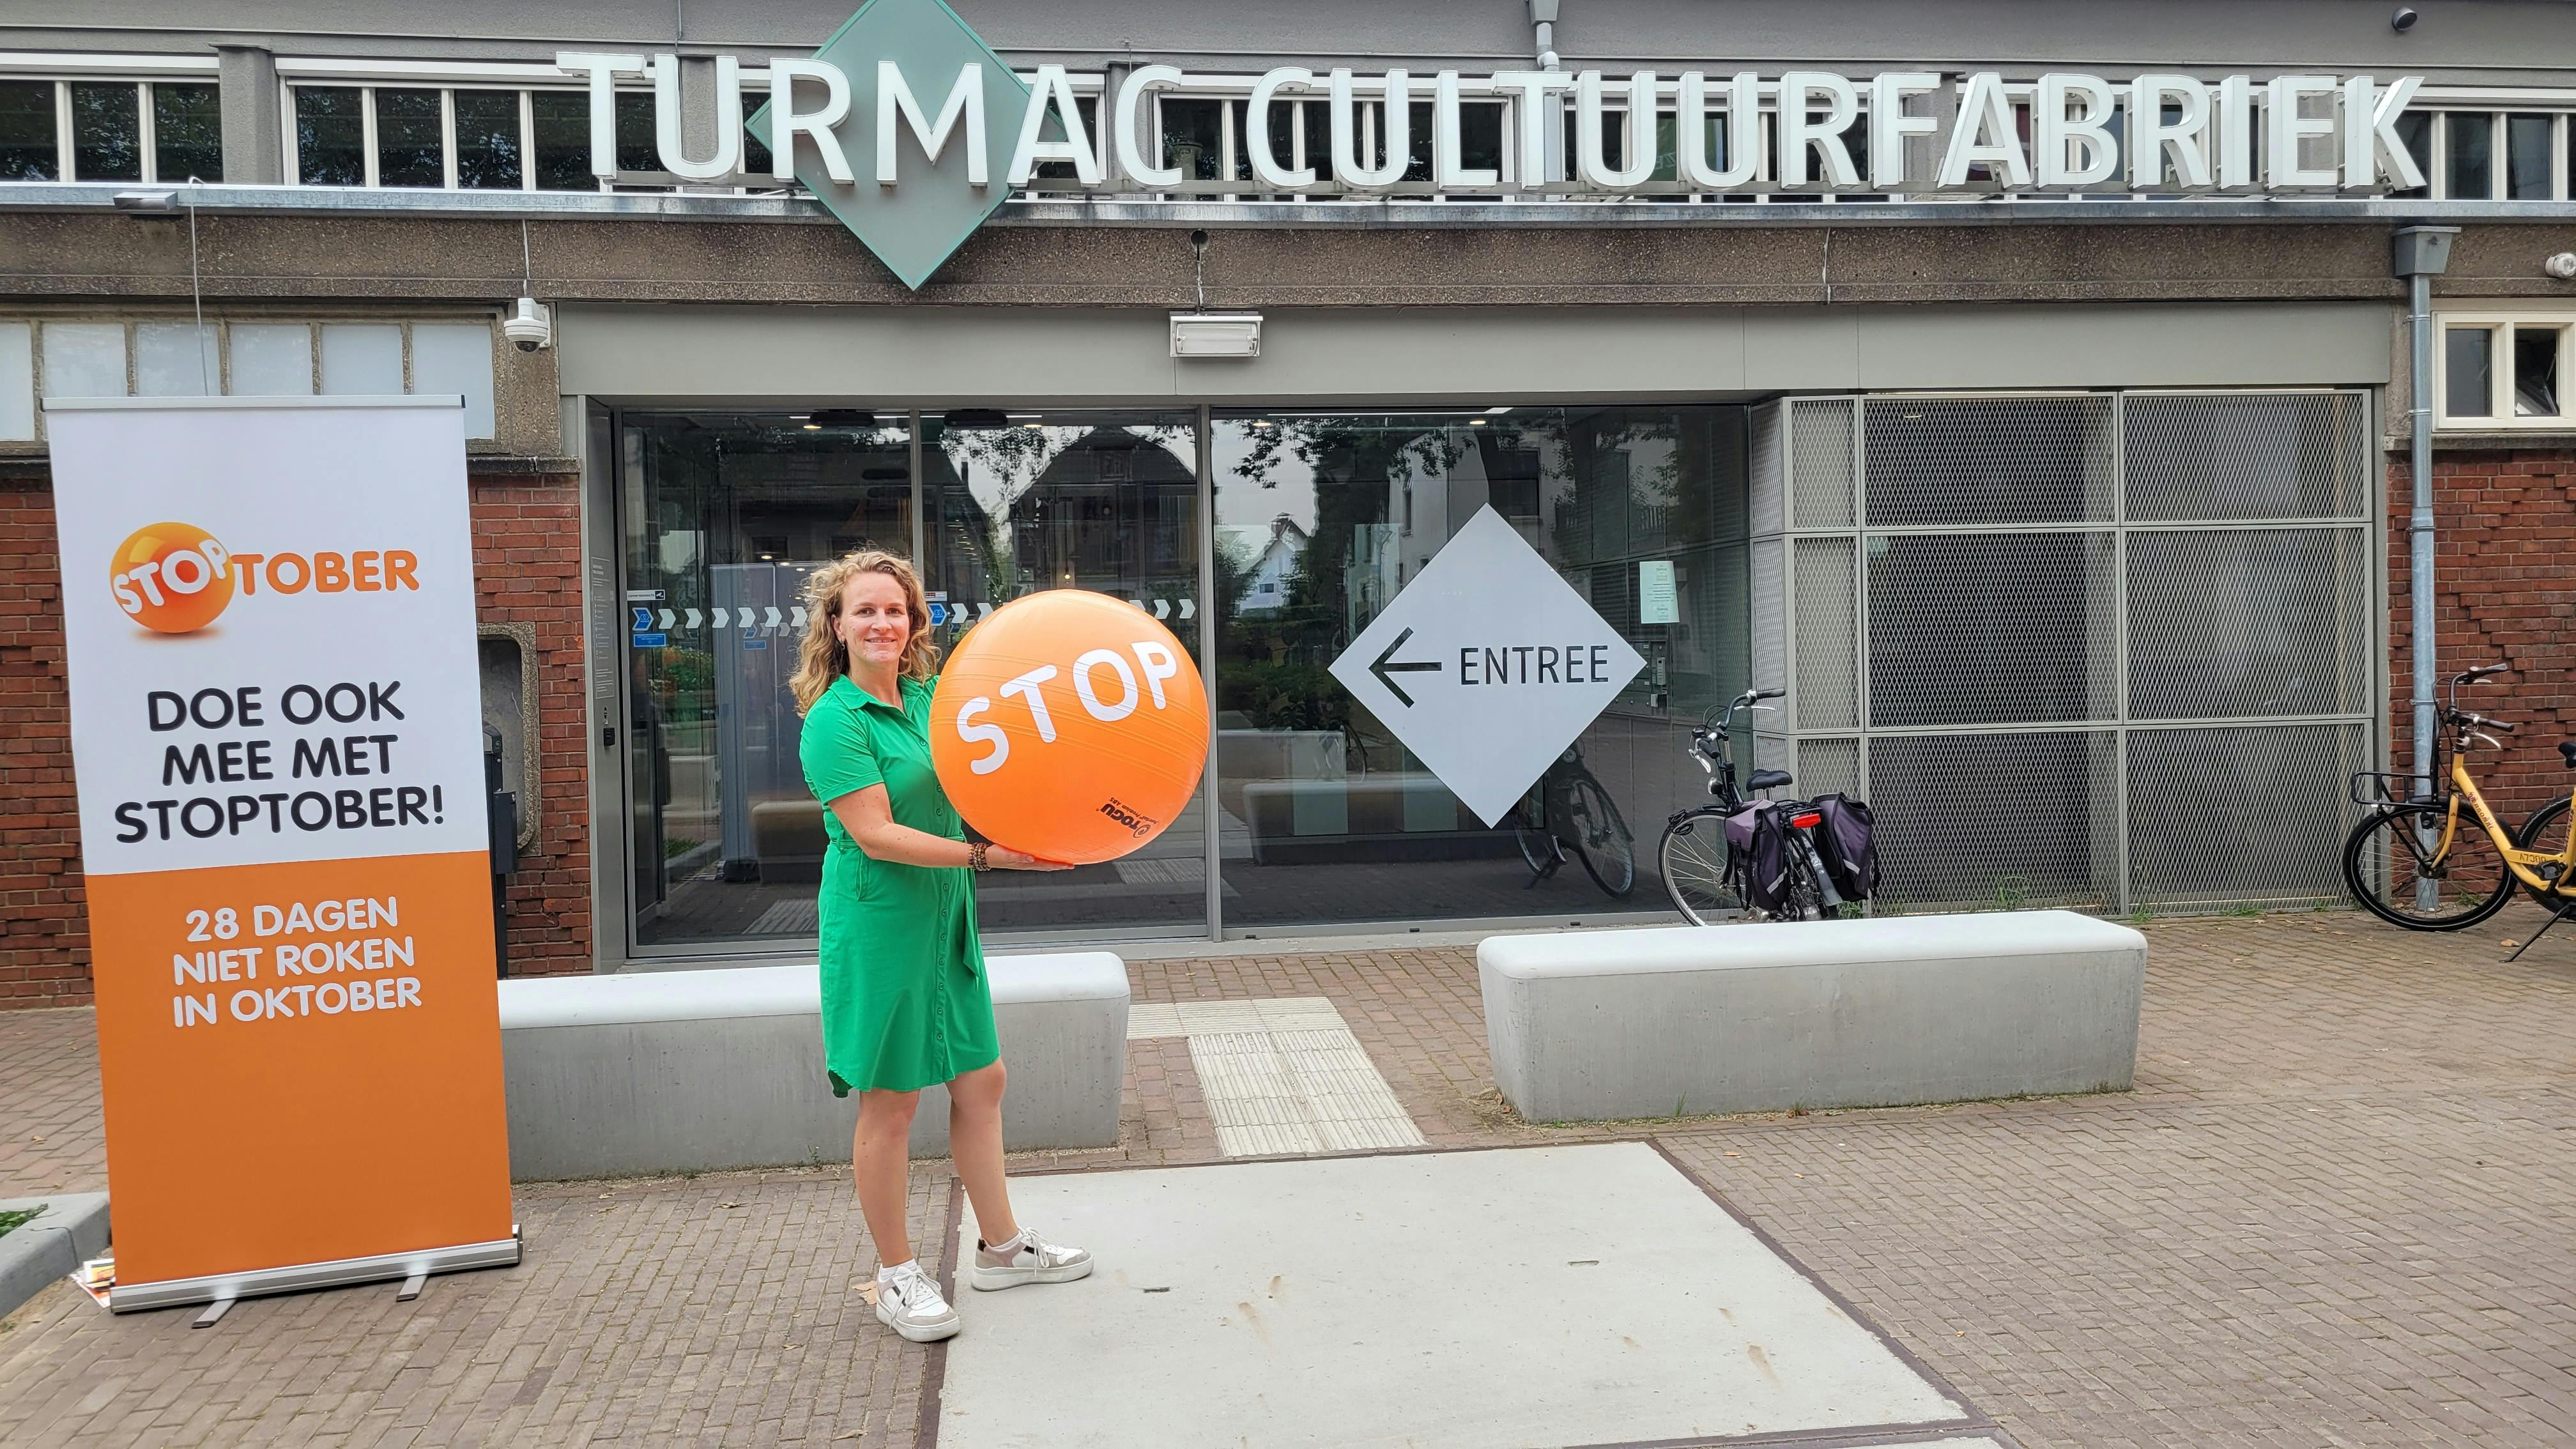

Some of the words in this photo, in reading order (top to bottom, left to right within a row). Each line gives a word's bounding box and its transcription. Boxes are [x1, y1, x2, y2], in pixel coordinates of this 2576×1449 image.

[556, 51, 1183, 187] TURMAC
[1246, 66, 2428, 190] CULTUURFABRIEK
[1460, 645, 1609, 685] ENTREE
[148, 686, 264, 732] DOE
[280, 680, 405, 725] OOK
[956, 641, 1177, 775] STOP
[162, 740, 273, 786] MEE
[292, 734, 398, 778] MET
[114, 785, 443, 843] STOPTOBER!
[1100, 803, 1141, 830] TOGU
[1109, 797, 1121, 806] ABS
[186, 908, 240, 942] 28
[253, 896, 398, 937] DAGEN
[173, 947, 263, 986] NIET
[275, 936, 415, 977] ROKEN
[173, 995, 217, 1027] IN
[229, 977, 422, 1022] OKTOBER
